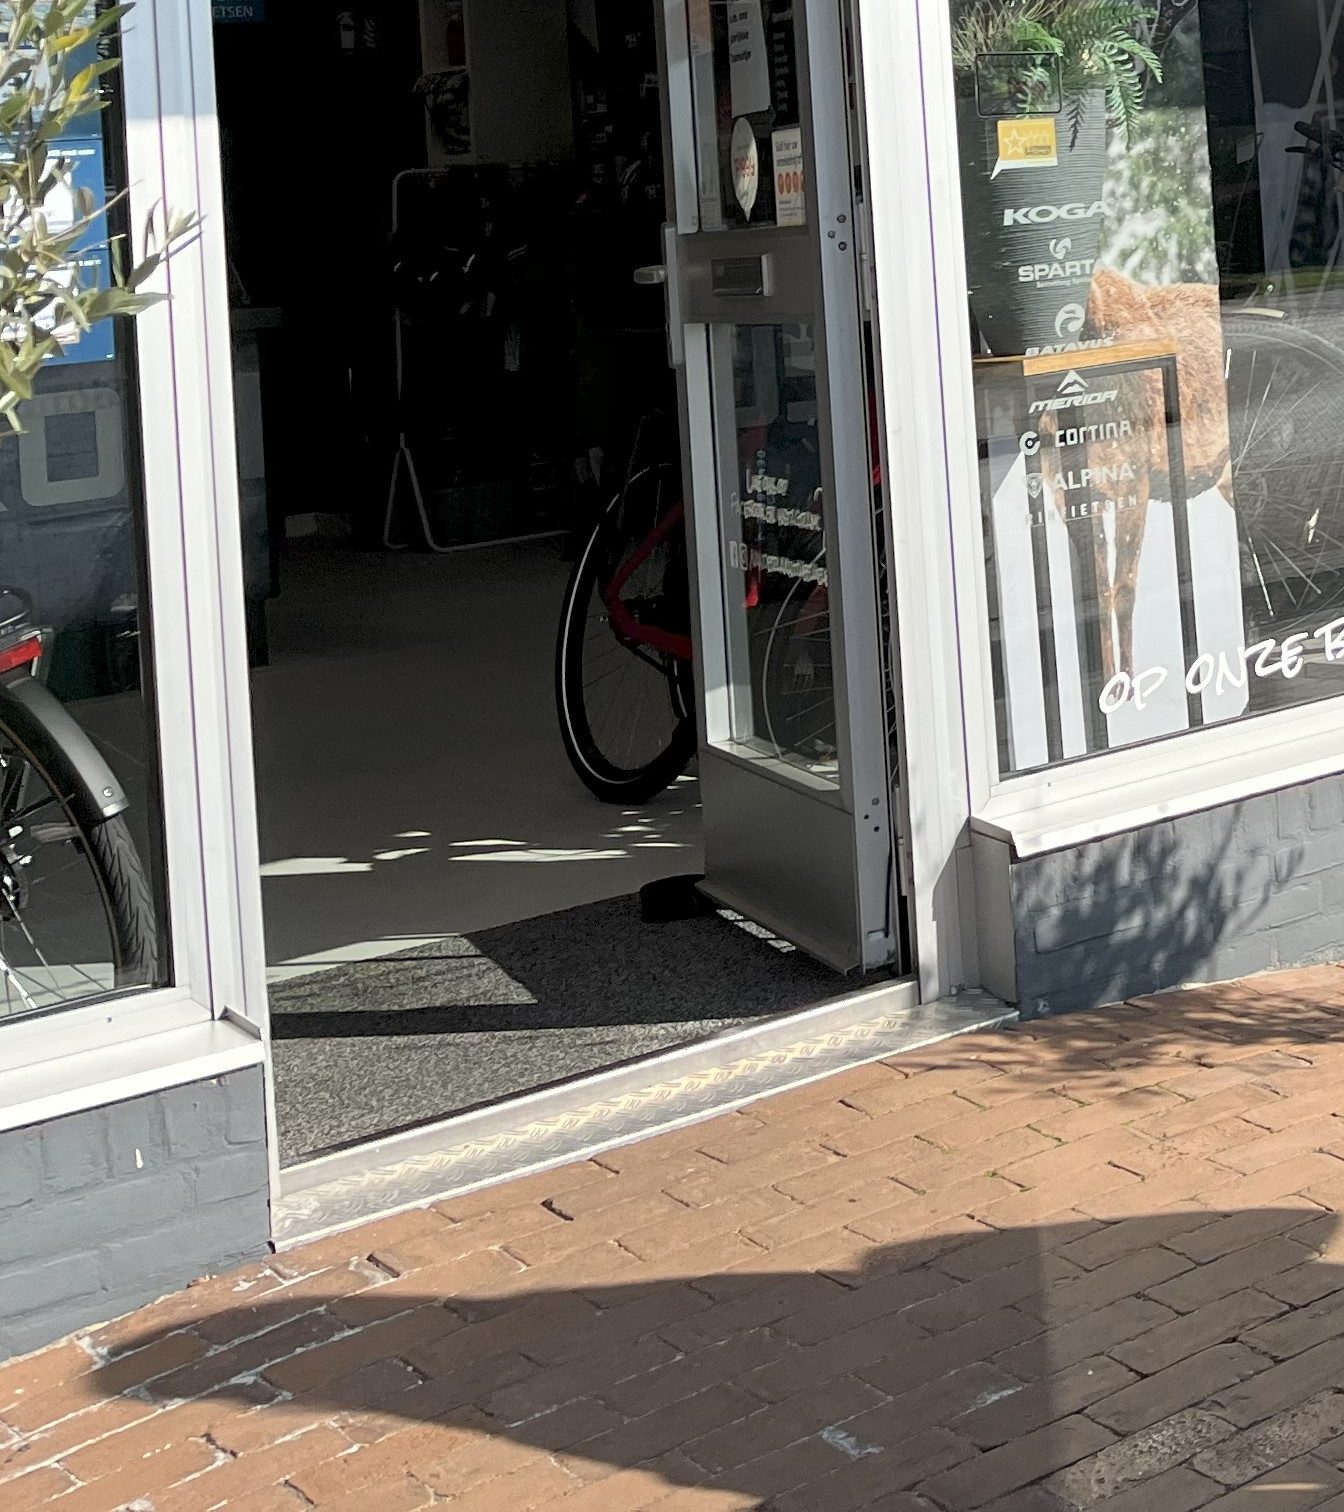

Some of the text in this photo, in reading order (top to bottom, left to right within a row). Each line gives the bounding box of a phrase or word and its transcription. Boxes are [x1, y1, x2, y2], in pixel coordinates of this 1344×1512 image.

[212, 5, 253, 18] ETSEN
[1003, 201, 1112, 226] KOGA
[1018, 259, 1095, 282] SPART
[1028, 390, 1118, 414] MERIDA
[1054, 462, 1135, 491] ALPINA
[1099, 665, 1167, 714] OP
[1186, 632, 1308, 696] ONZE
